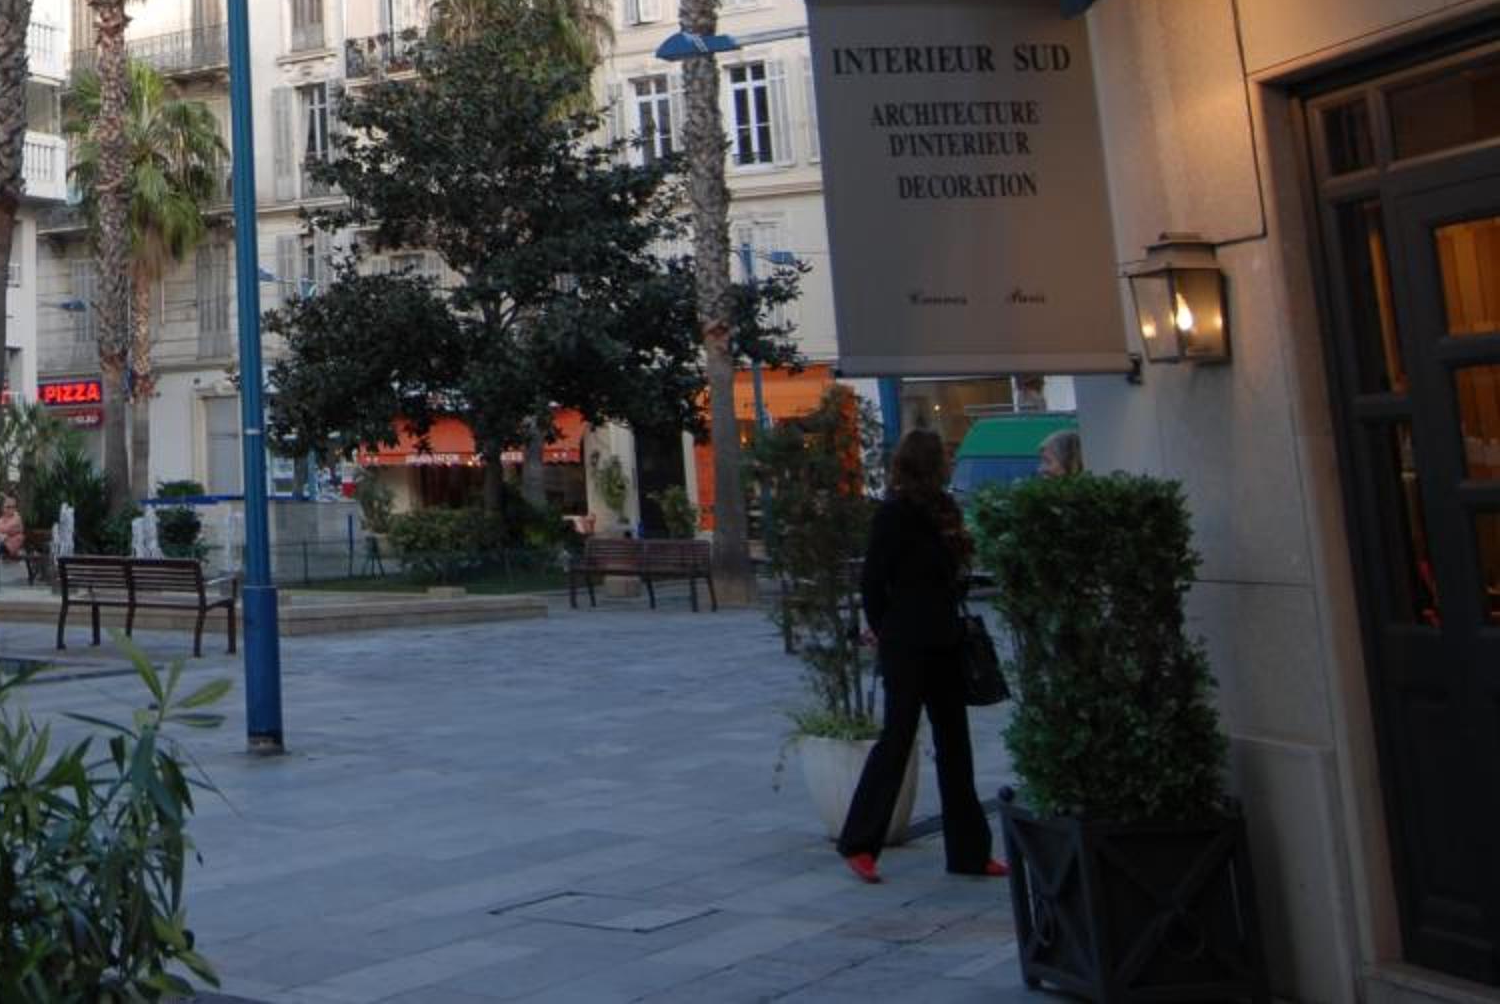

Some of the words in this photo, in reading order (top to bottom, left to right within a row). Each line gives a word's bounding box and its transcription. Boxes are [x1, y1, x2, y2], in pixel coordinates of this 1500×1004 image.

[832, 45, 995, 75] INTERIEUR
[1013, 43, 1070, 73] SUD
[870, 100, 1040, 126] ARCHITECTURE
[889, 131, 1031, 158] D'INTERIEUR
[898, 171, 1038, 200] DECORATION
[43, 382, 101, 403] PIZZA
